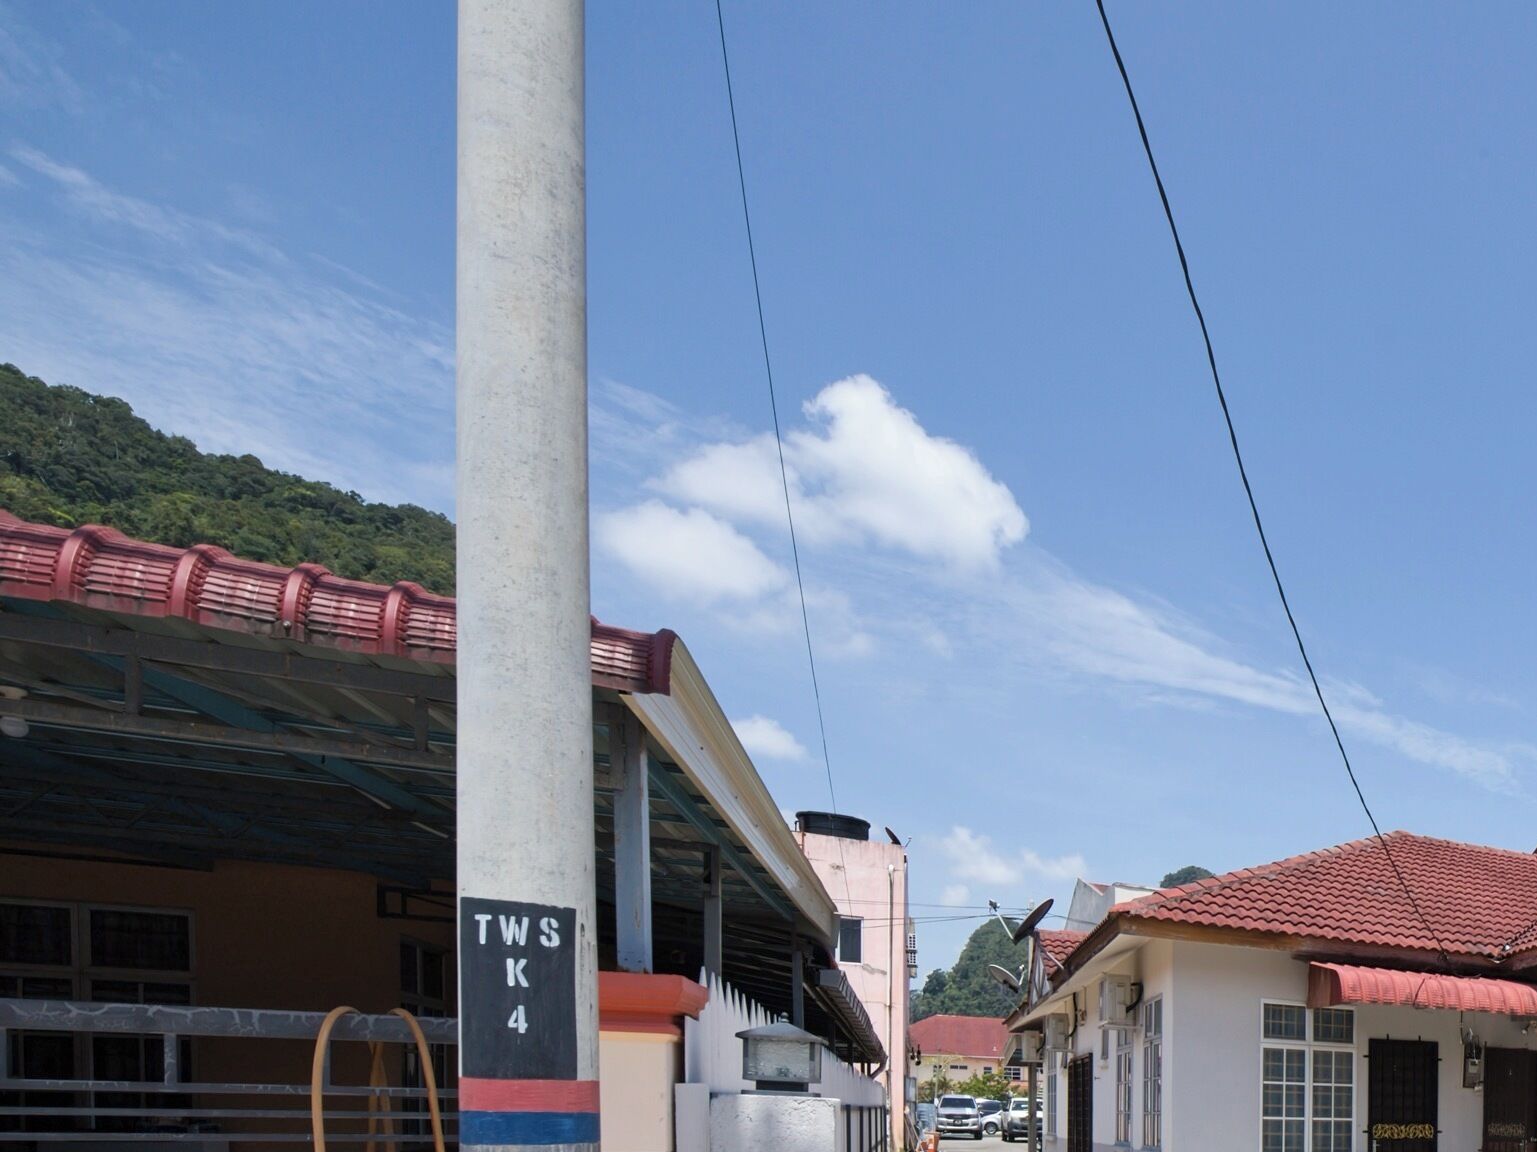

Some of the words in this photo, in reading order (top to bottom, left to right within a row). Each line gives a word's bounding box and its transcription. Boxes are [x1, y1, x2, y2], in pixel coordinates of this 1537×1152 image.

[474, 914, 560, 947] TWS
[506, 958, 529, 987] K
[508, 1005, 528, 1033] 4
